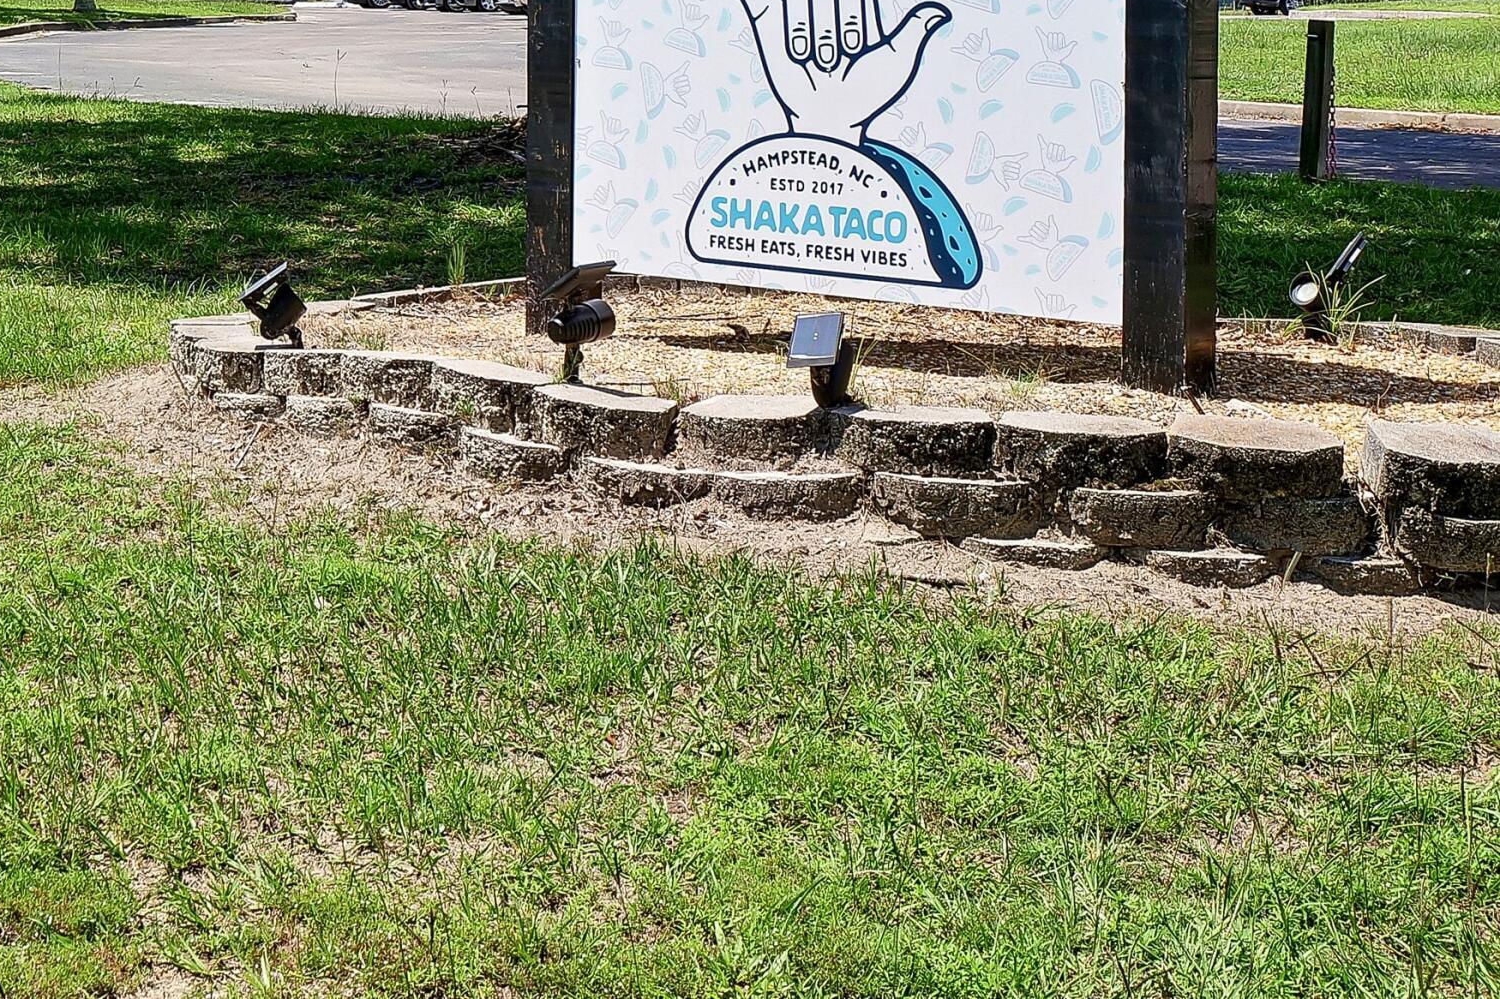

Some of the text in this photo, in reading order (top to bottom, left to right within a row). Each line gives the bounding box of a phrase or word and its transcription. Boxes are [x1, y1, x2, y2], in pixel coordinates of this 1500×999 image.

[742, 150, 843, 177] HAMPSTEAD,
[850, 165, 875, 189] NC
[770, 178, 844, 196] ESTD 2017
[710, 196, 907, 244] SHAKA TACO
[709, 235, 907, 267] FRESH EATS, FRESH VIBES
